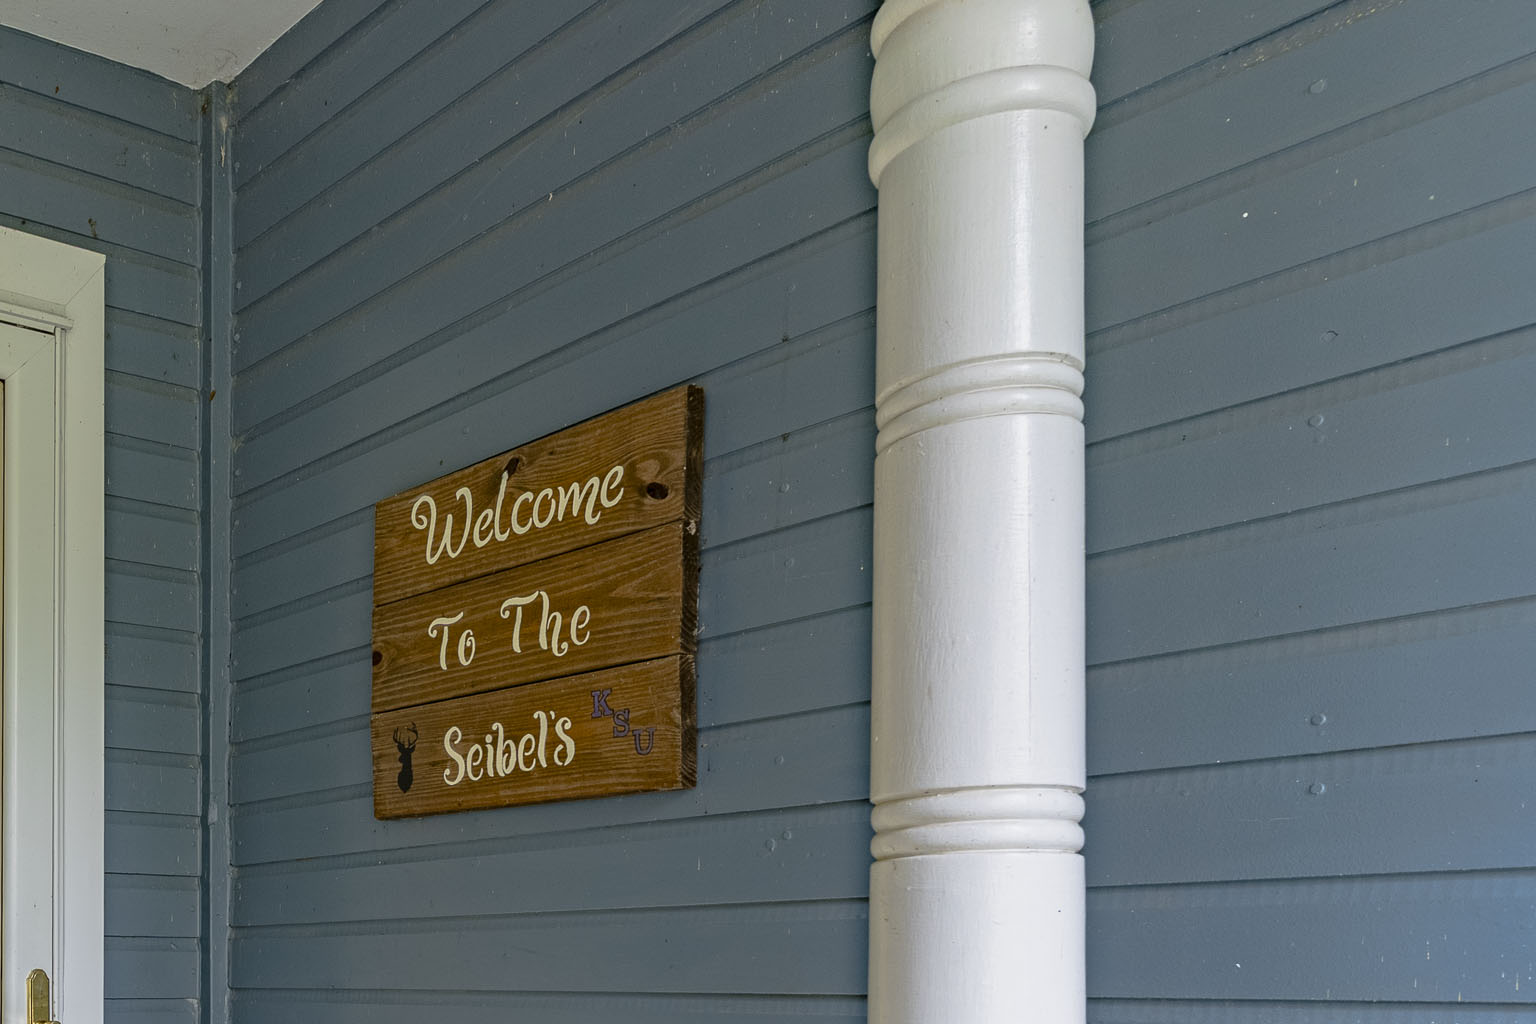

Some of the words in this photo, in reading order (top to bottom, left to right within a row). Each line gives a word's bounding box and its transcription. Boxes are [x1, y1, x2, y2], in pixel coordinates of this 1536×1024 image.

[411, 465, 625, 565] Welcome
[428, 611, 476, 671] To
[500, 590, 591, 657] The
[443, 710, 575, 786] Seibel's
[590, 688, 656, 756] KSU
